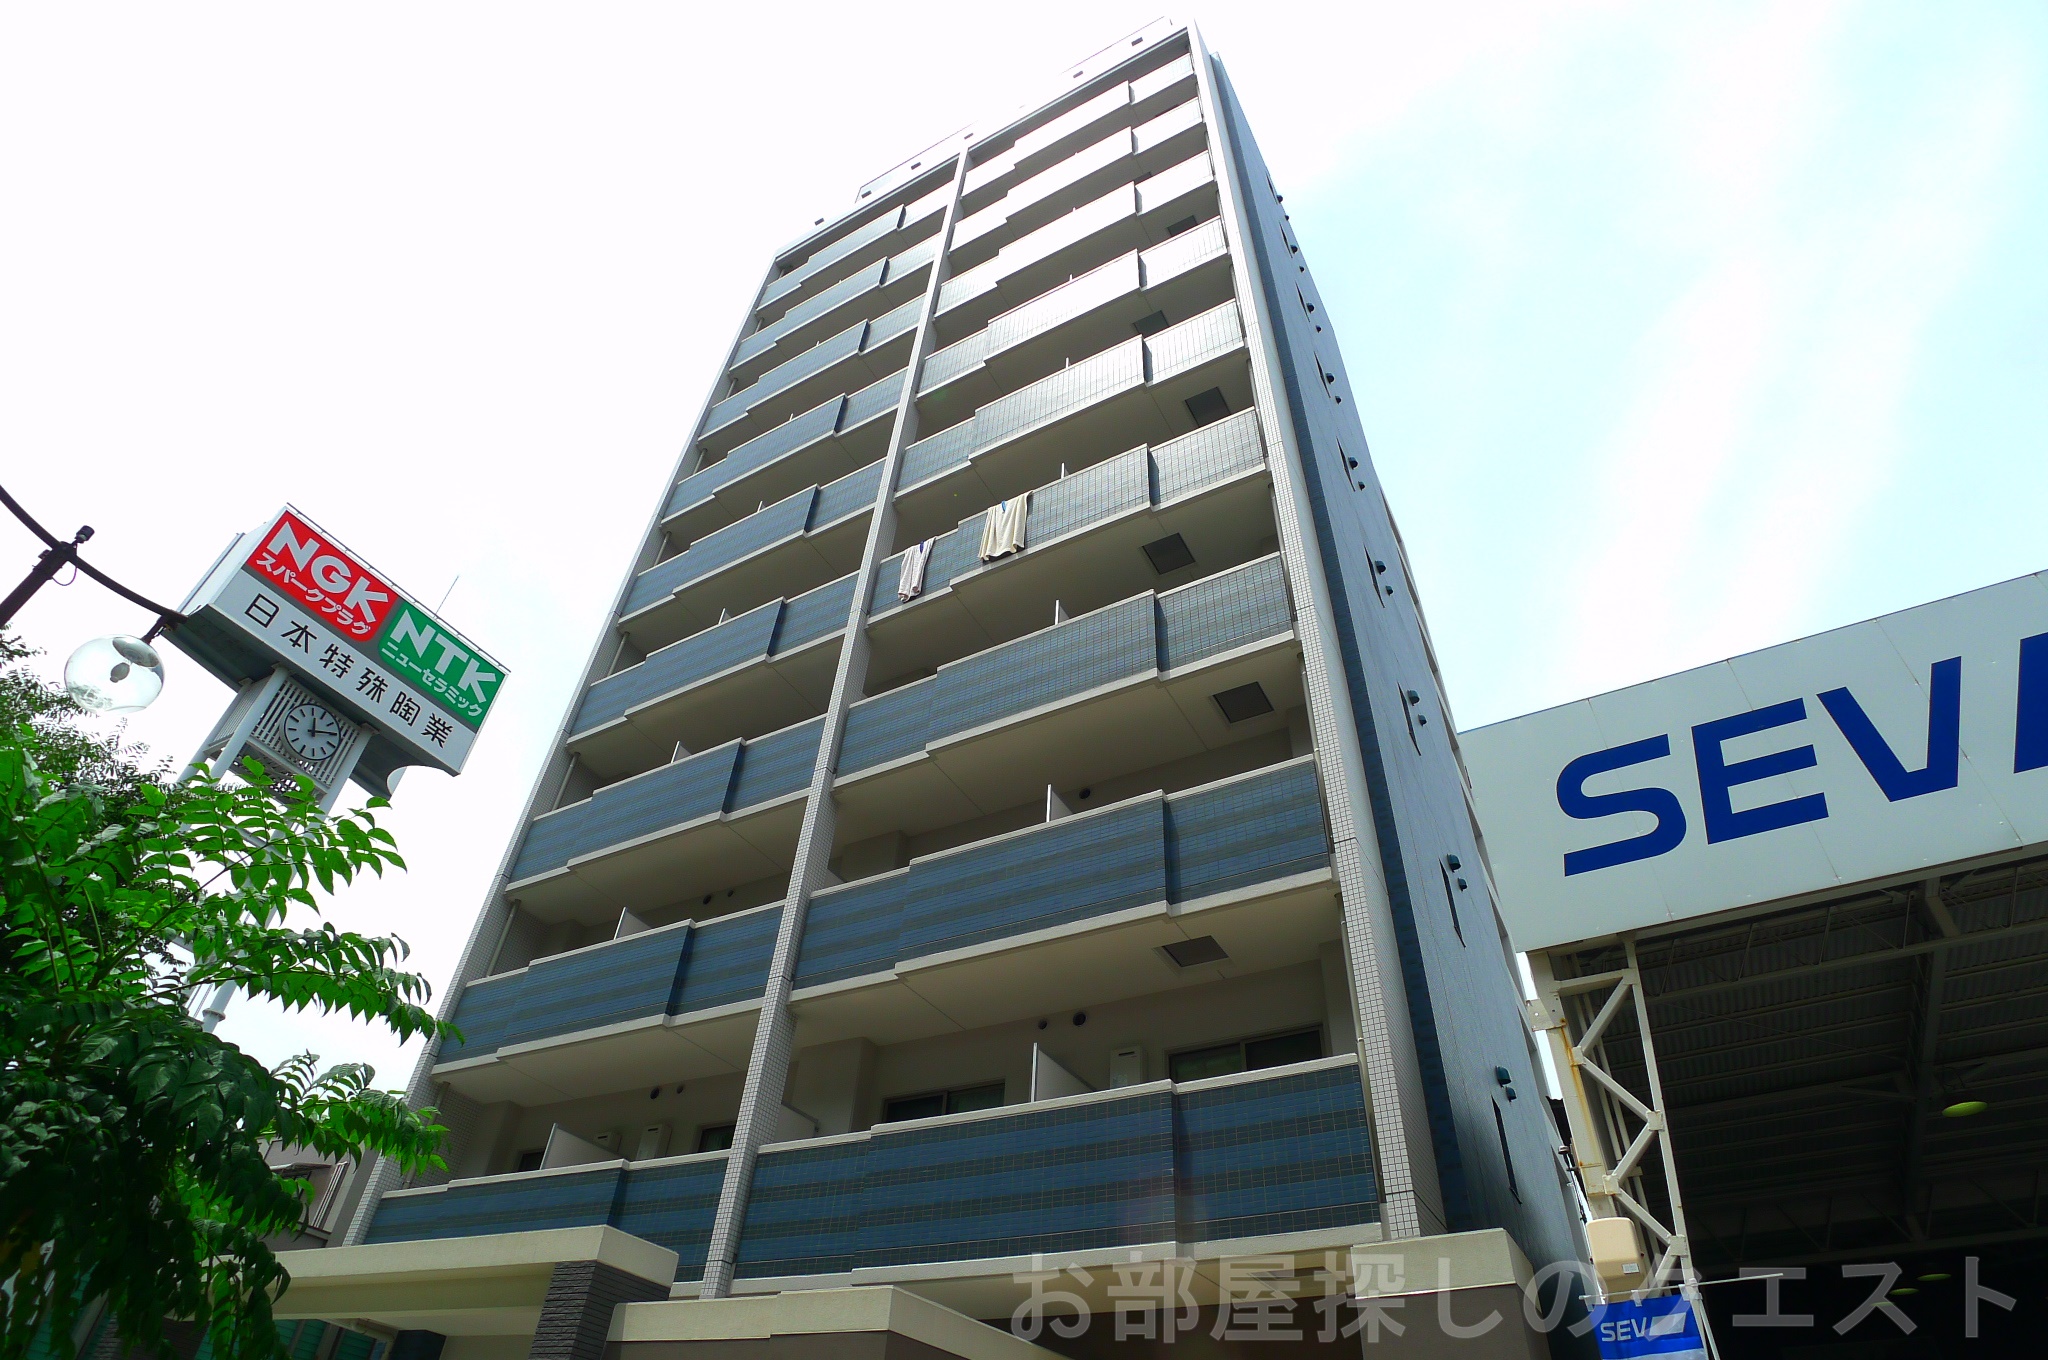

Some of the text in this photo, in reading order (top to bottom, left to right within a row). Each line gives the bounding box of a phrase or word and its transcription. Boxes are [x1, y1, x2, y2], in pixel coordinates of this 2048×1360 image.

[256, 552, 371, 634] スパークプラグ
[266, 521, 388, 623] NGK
[244, 593, 453, 749] 日本特殊陶業
[381, 641, 483, 717] ニューセラミック
[390, 609, 496, 703] NTK
[1600, 1317, 1647, 1342] SEV
